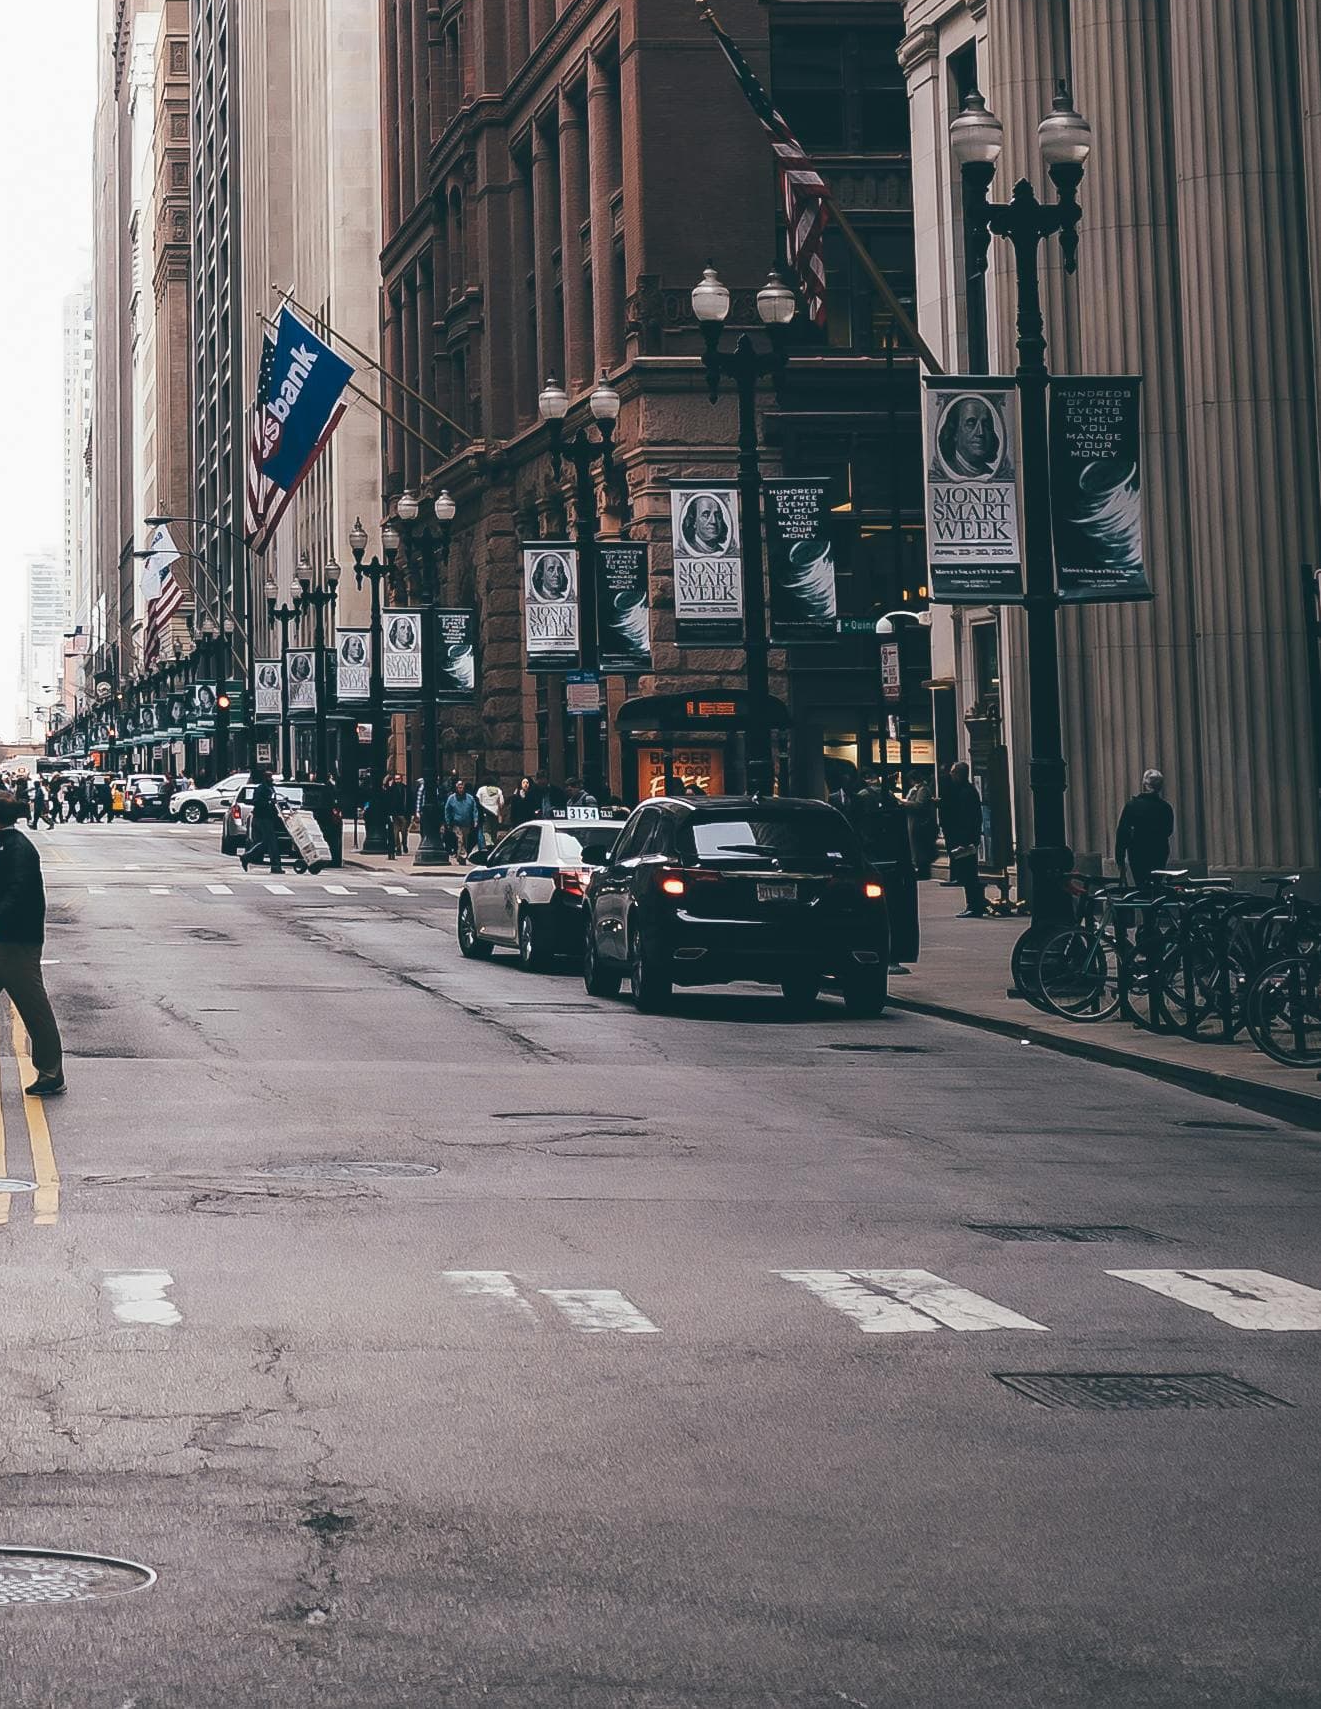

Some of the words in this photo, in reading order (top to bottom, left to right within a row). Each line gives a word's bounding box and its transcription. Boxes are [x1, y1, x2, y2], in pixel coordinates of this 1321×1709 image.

[1058, 390, 1131, 398] HUNDREDS
[1089, 399, 1121, 407] FREE
[1068, 407, 1120, 415] EVENTS
[1066, 415, 1082, 423] TO
[1080, 424, 1107, 432] YOU
[1066, 433, 1121, 441] MANAGE
[1076, 441, 1112, 449] YOUR
[1070, 450, 1119, 458] MONEY
[933, 487, 1010, 504] MONEY
[933, 503, 1011, 521] SMART
[933, 520, 1013, 540] WEEK
[679, 561, 737, 574] MONEY
[679, 572, 737, 587] SMART
[679, 585, 738, 601] WEEK
[529, 606, 575, 617] MONEY
[529, 615, 574, 627] SMART
[530, 625, 575, 637] WEEK
[569, 808, 598, 820] 3154
